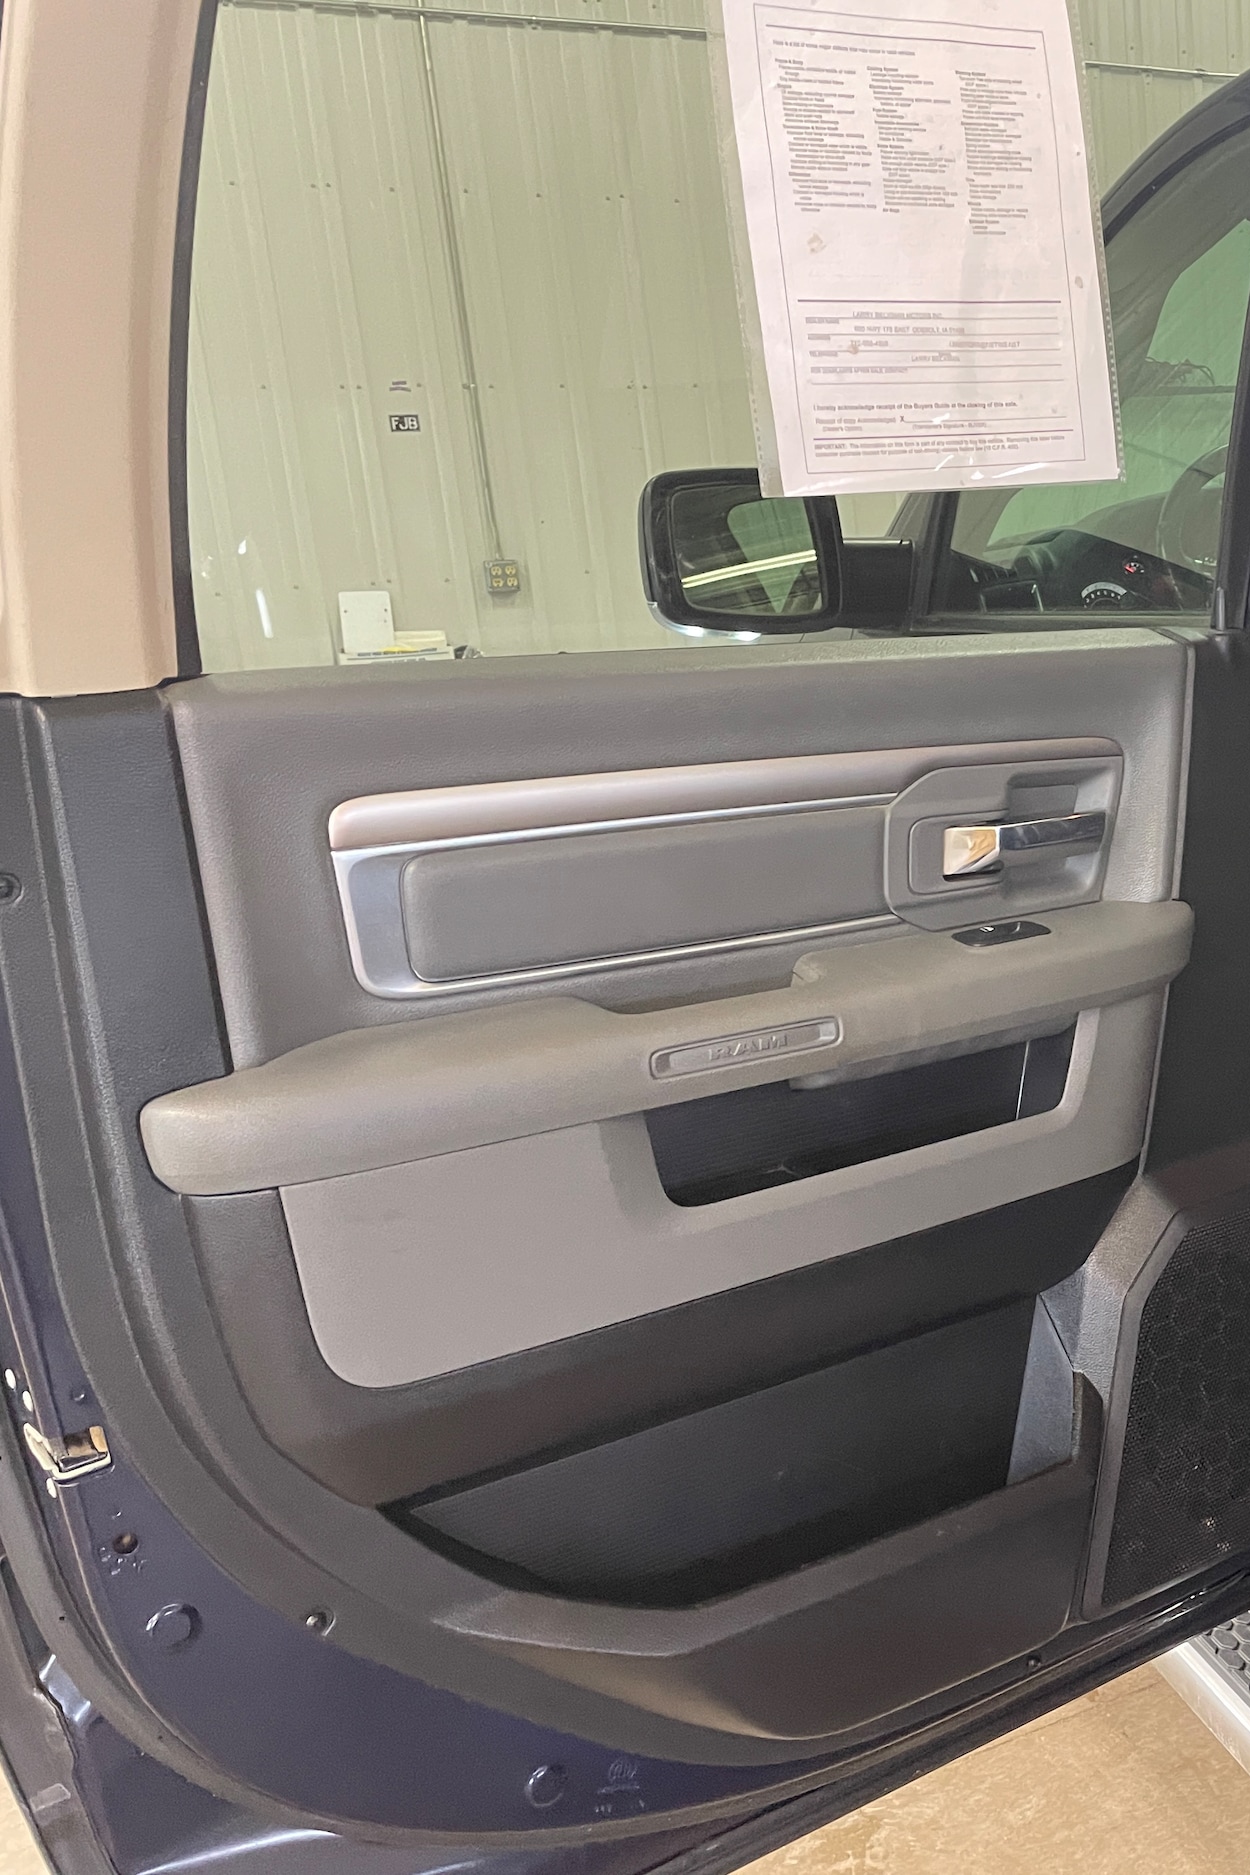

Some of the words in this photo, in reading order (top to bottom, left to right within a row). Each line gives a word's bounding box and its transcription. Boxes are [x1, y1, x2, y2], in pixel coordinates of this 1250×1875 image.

[914, 402, 933, 411] Buyers
[390, 416, 419, 431] FJB
[708, 1033, 788, 1061] RAM
